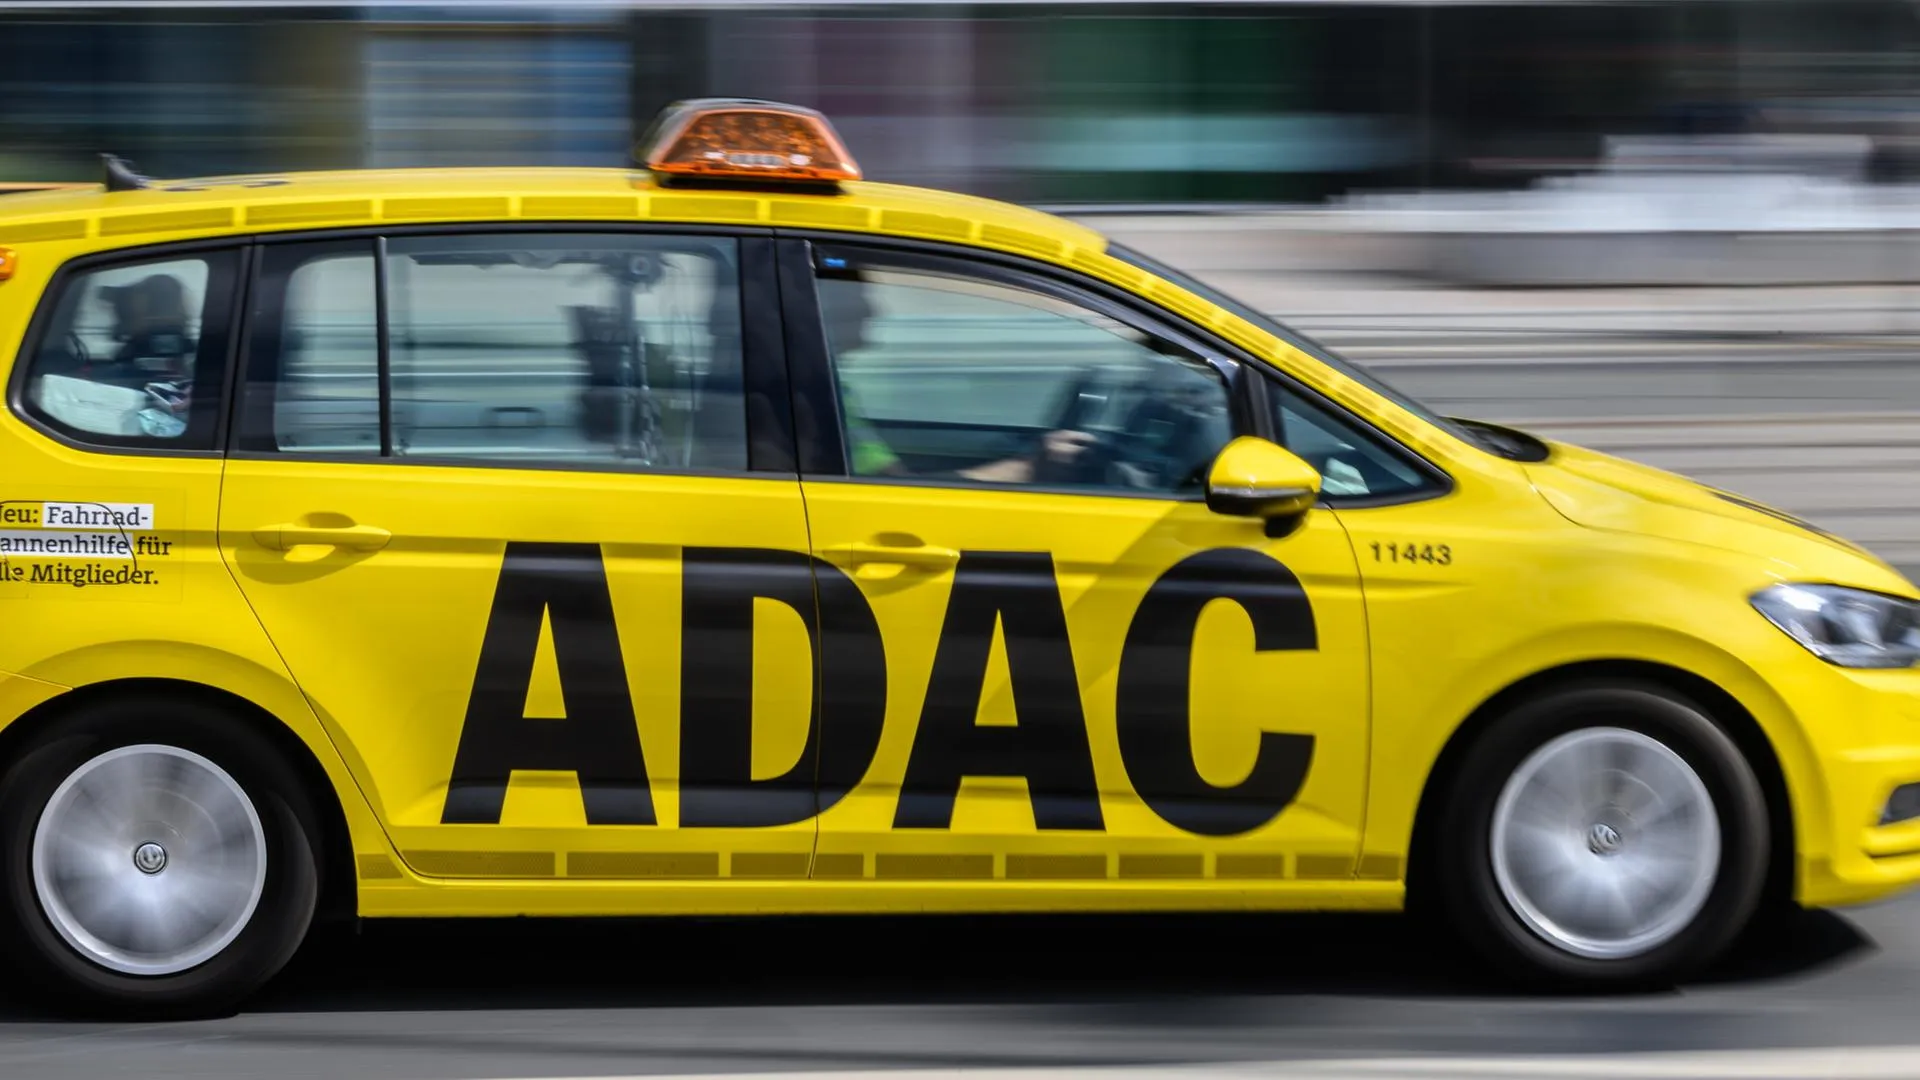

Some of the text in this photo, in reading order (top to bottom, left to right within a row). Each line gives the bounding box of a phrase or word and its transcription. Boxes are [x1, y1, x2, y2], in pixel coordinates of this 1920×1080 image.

[47, 506, 149, 527] Fahrrad-
[137, 536, 172, 556] für
[1369, 541, 1452, 566] 11443
[30, 563, 160, 588] Mitglieder.
[440, 541, 1319, 837] ADAC
